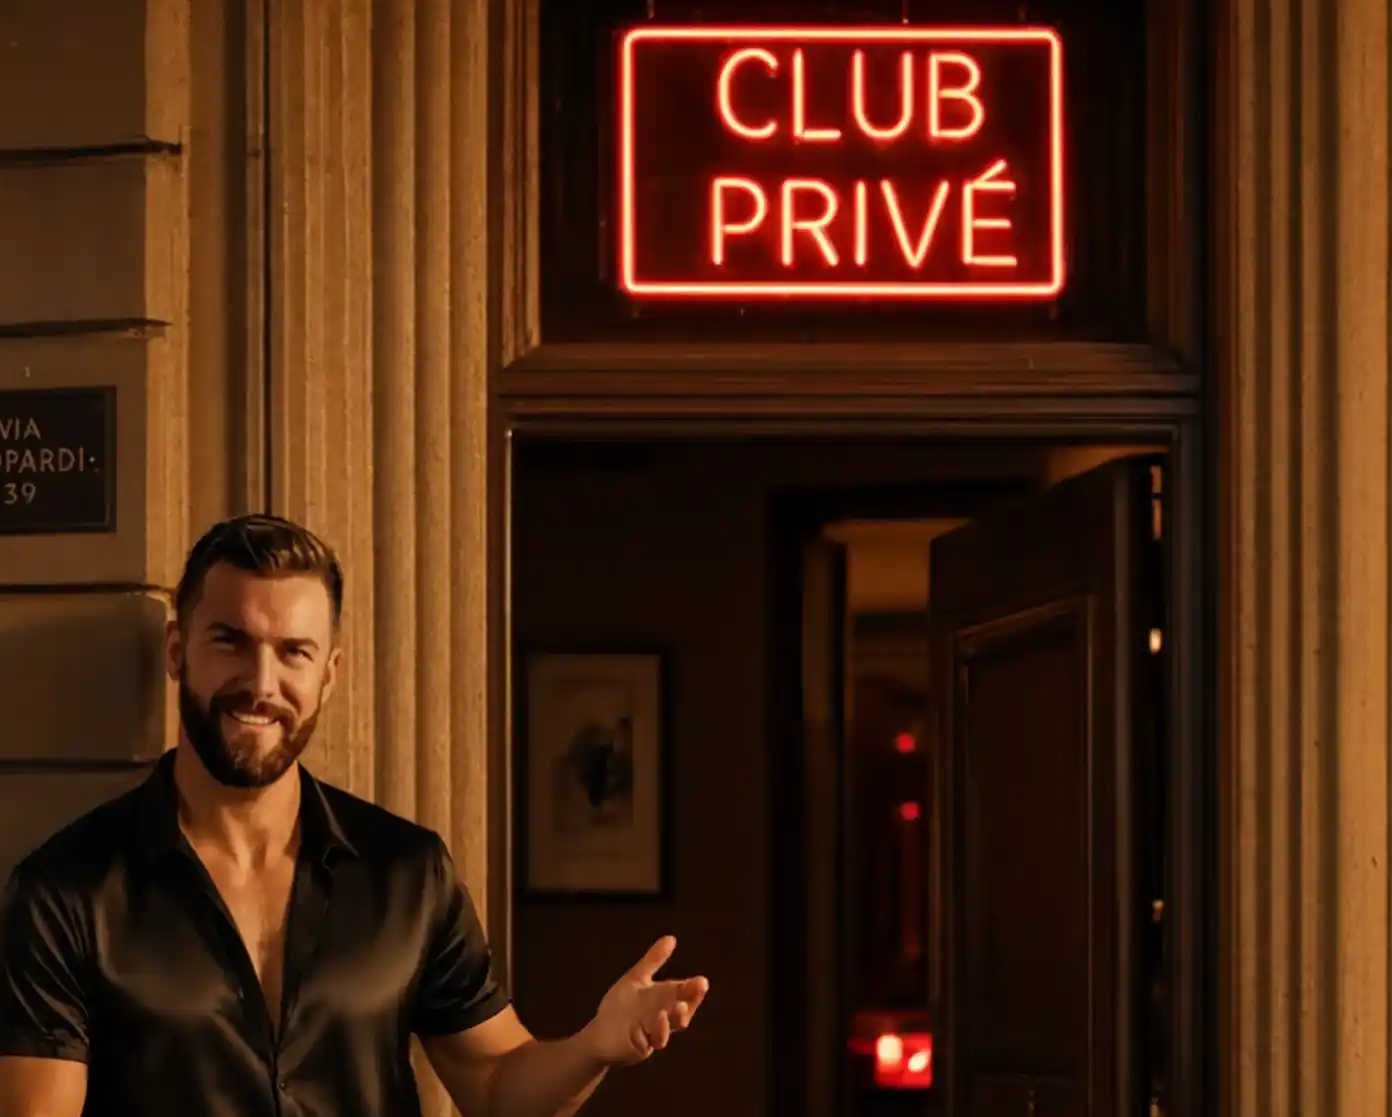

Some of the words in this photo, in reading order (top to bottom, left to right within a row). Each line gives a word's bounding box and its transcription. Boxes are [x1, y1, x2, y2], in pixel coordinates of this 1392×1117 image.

[715, 46, 987, 143] CLUB
[711, 157, 1019, 270] PRIVÉ
[3, 481, 37, 505] 39
